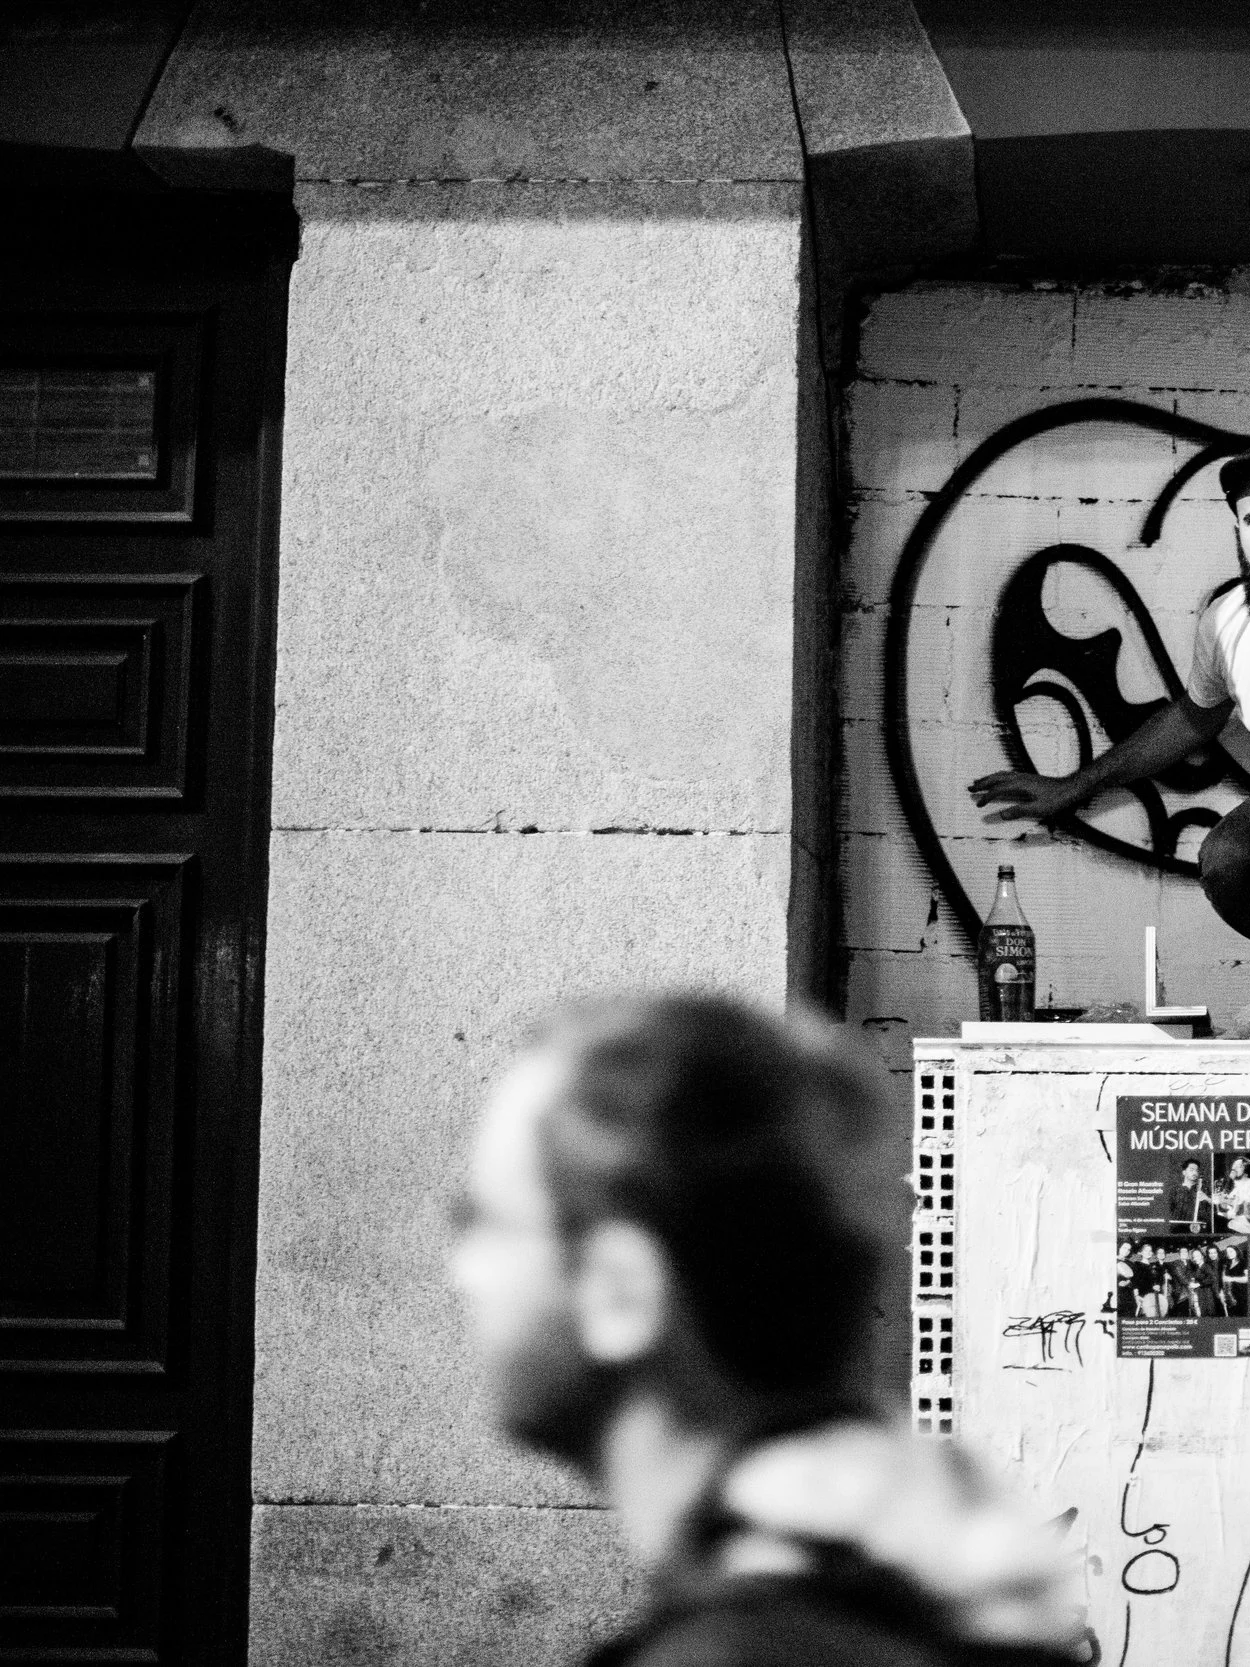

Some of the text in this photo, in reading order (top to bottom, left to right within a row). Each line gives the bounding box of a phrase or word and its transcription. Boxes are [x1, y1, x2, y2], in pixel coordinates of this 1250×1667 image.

[1006, 937, 1027, 946] DON
[1141, 1101, 1231, 1123] SEMANA
[1130, 1125, 1214, 1151] MÚSICA
